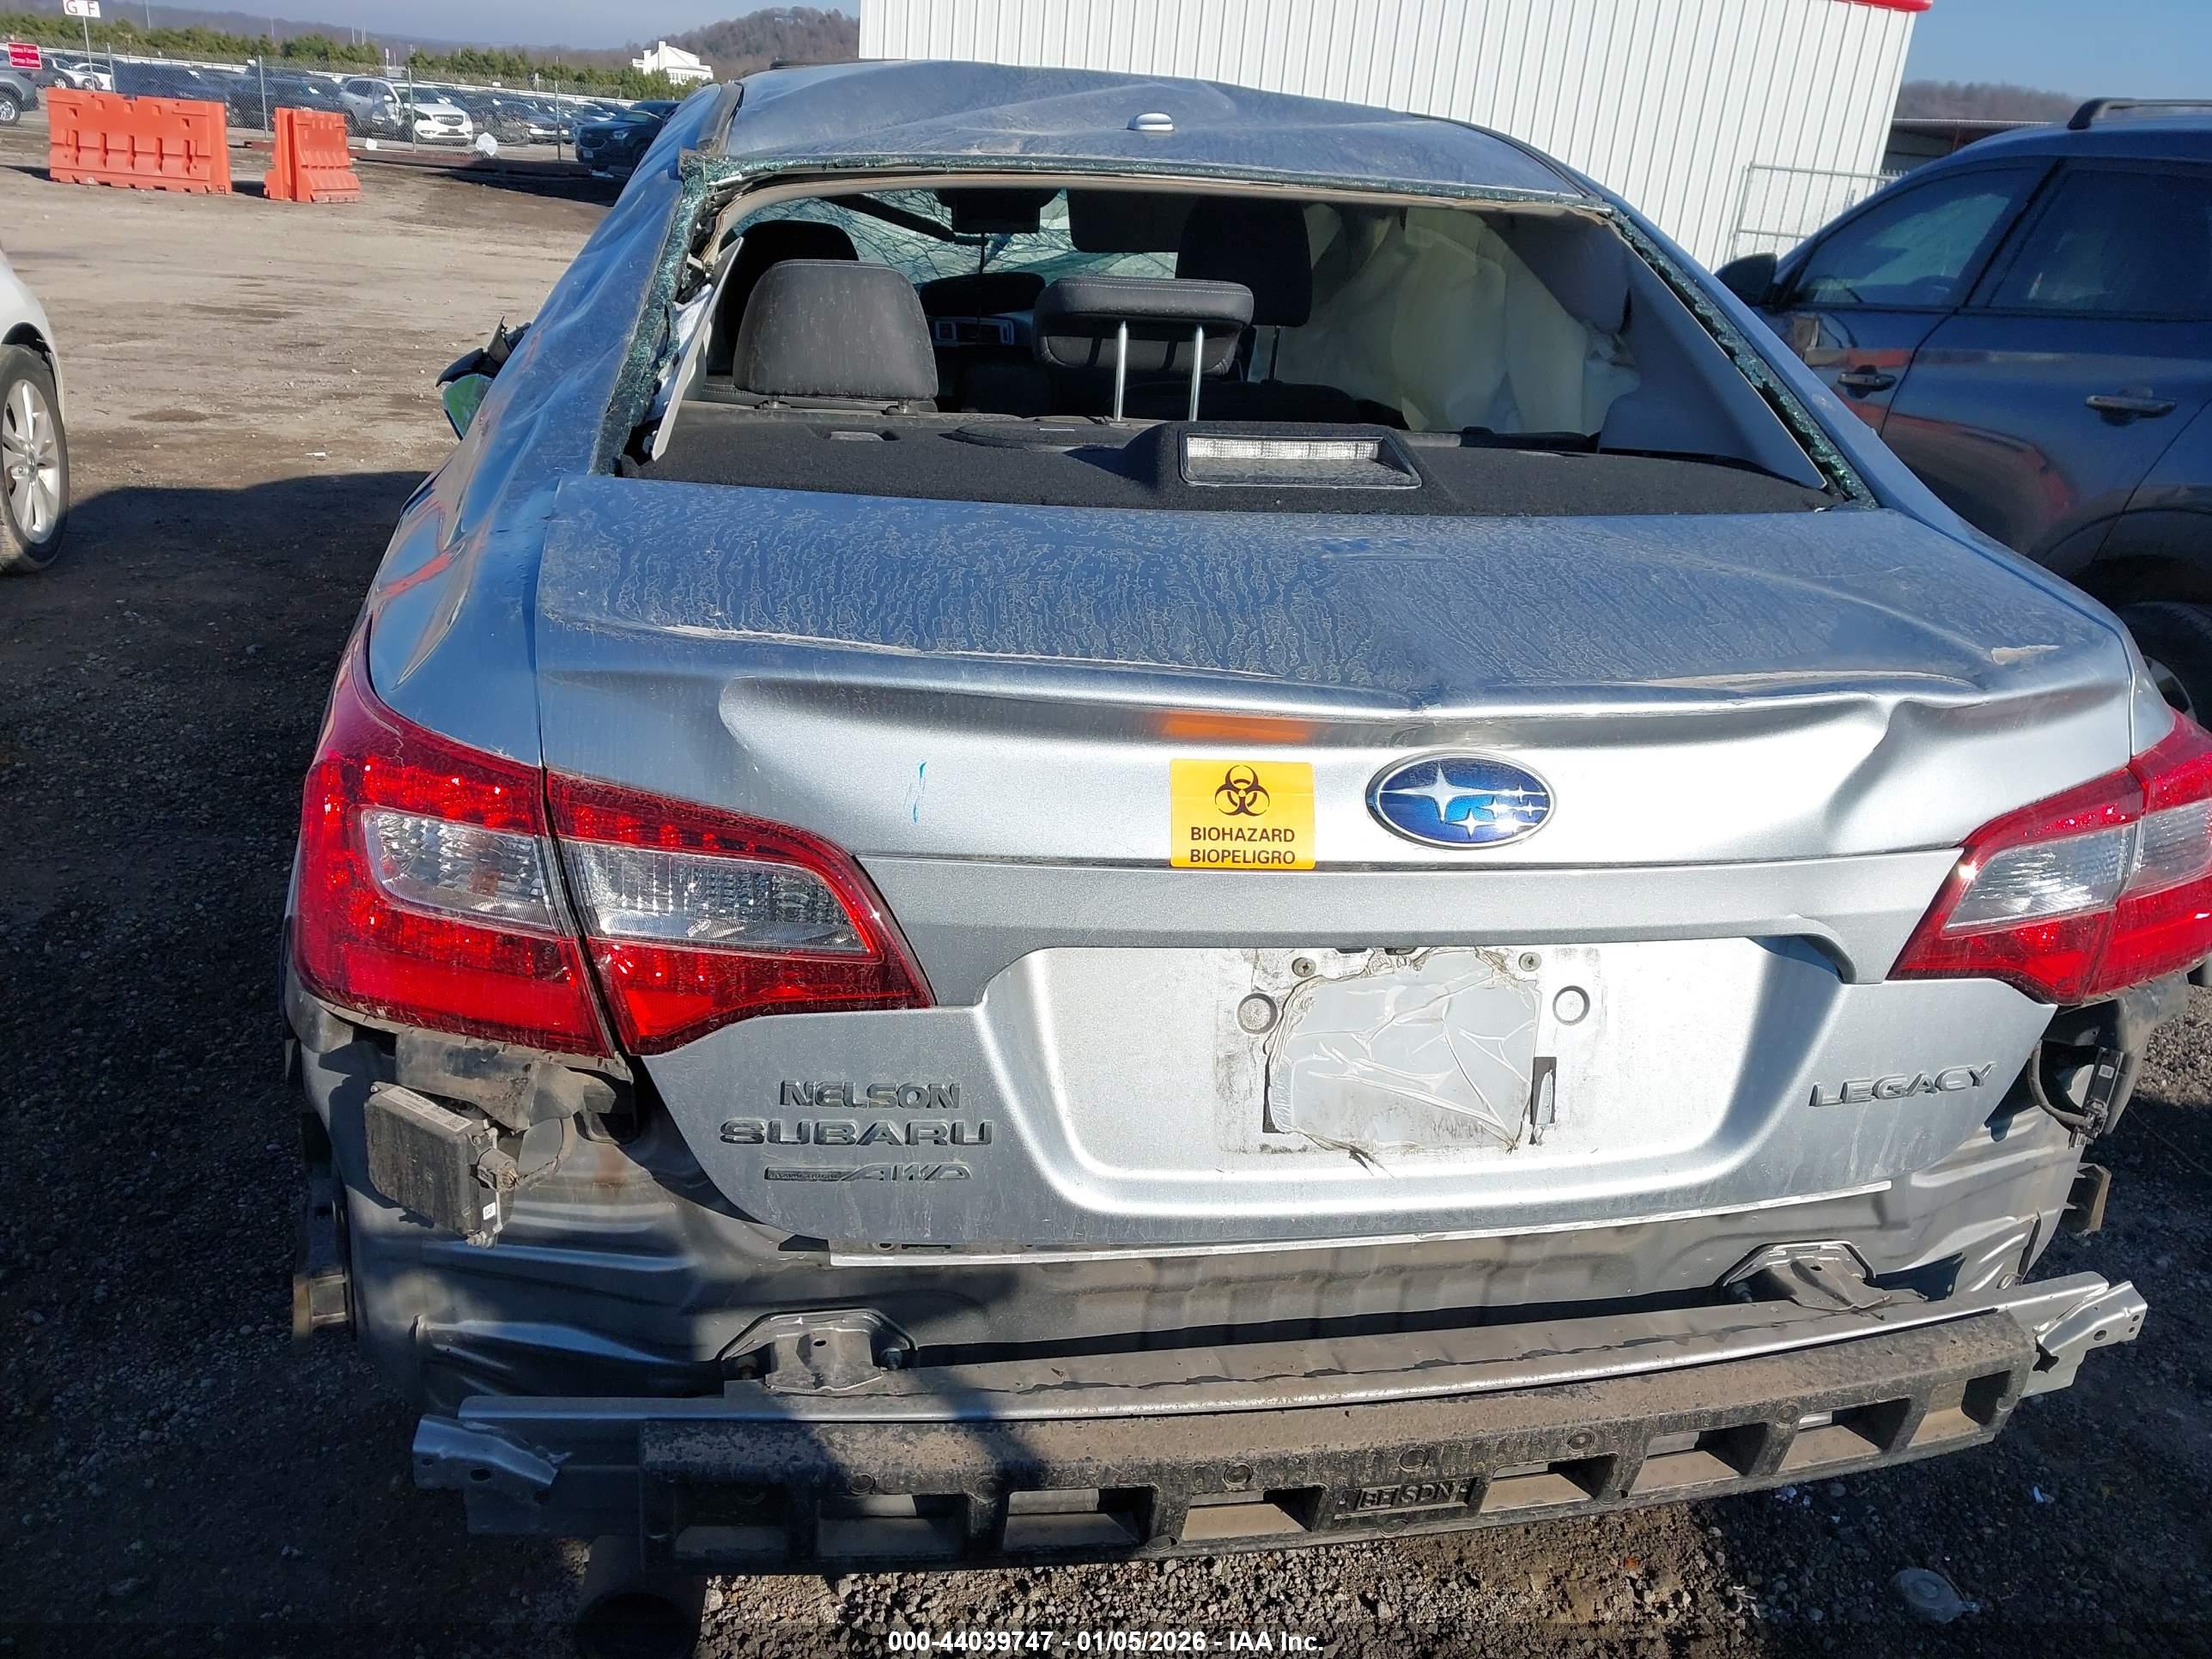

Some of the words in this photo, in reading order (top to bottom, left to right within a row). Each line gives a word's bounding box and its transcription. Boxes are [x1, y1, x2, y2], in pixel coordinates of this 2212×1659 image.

[66, 0, 78, 14] G
[87, 1, 95, 15] F
[1190, 827, 1296, 842] BIOHAZARD
[1189, 849, 1296, 865] BIOPELIGRO
[780, 1079, 963, 1109] NELSON
[1808, 1062, 1996, 1107] LEGACY
[720, 1119, 994, 1146] SUBARU
[840, 1163, 974, 1182] AWD
